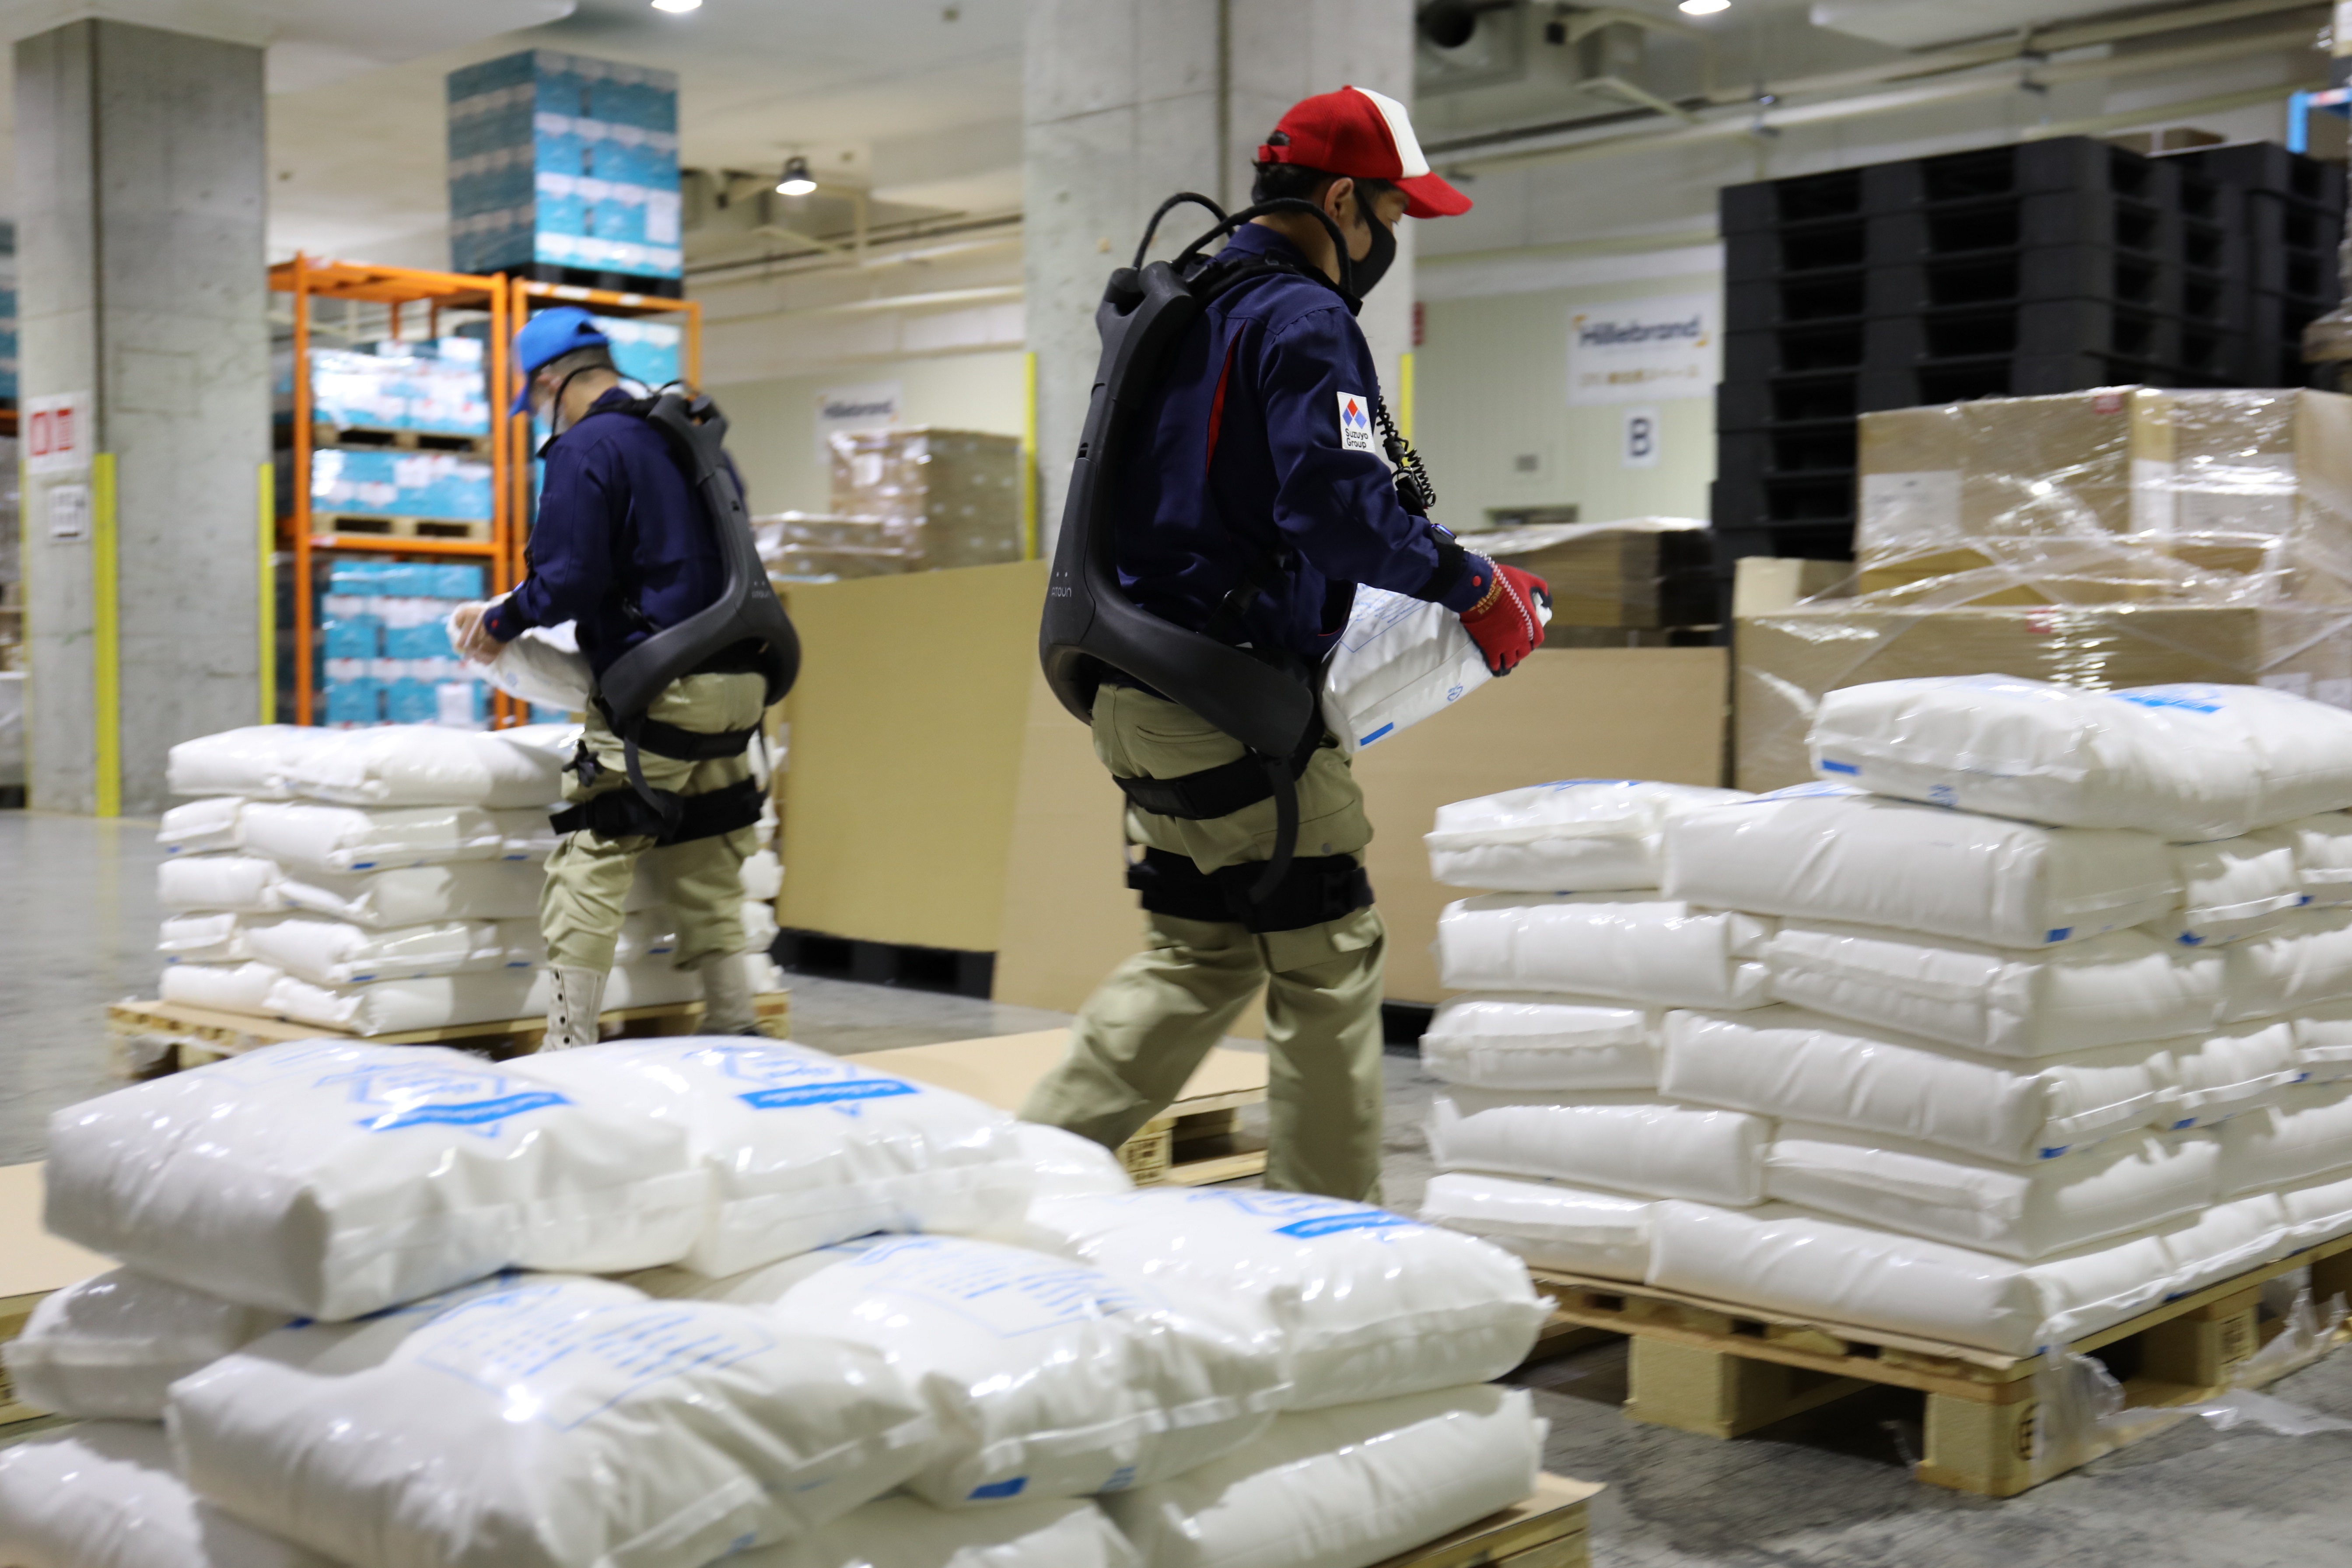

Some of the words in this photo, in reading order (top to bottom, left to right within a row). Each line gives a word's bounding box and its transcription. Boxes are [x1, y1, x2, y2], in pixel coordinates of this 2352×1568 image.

[1345, 428, 1368, 441] Suzuyo
[1630, 417, 1651, 457] B
[1347, 438, 1367, 449] Group
